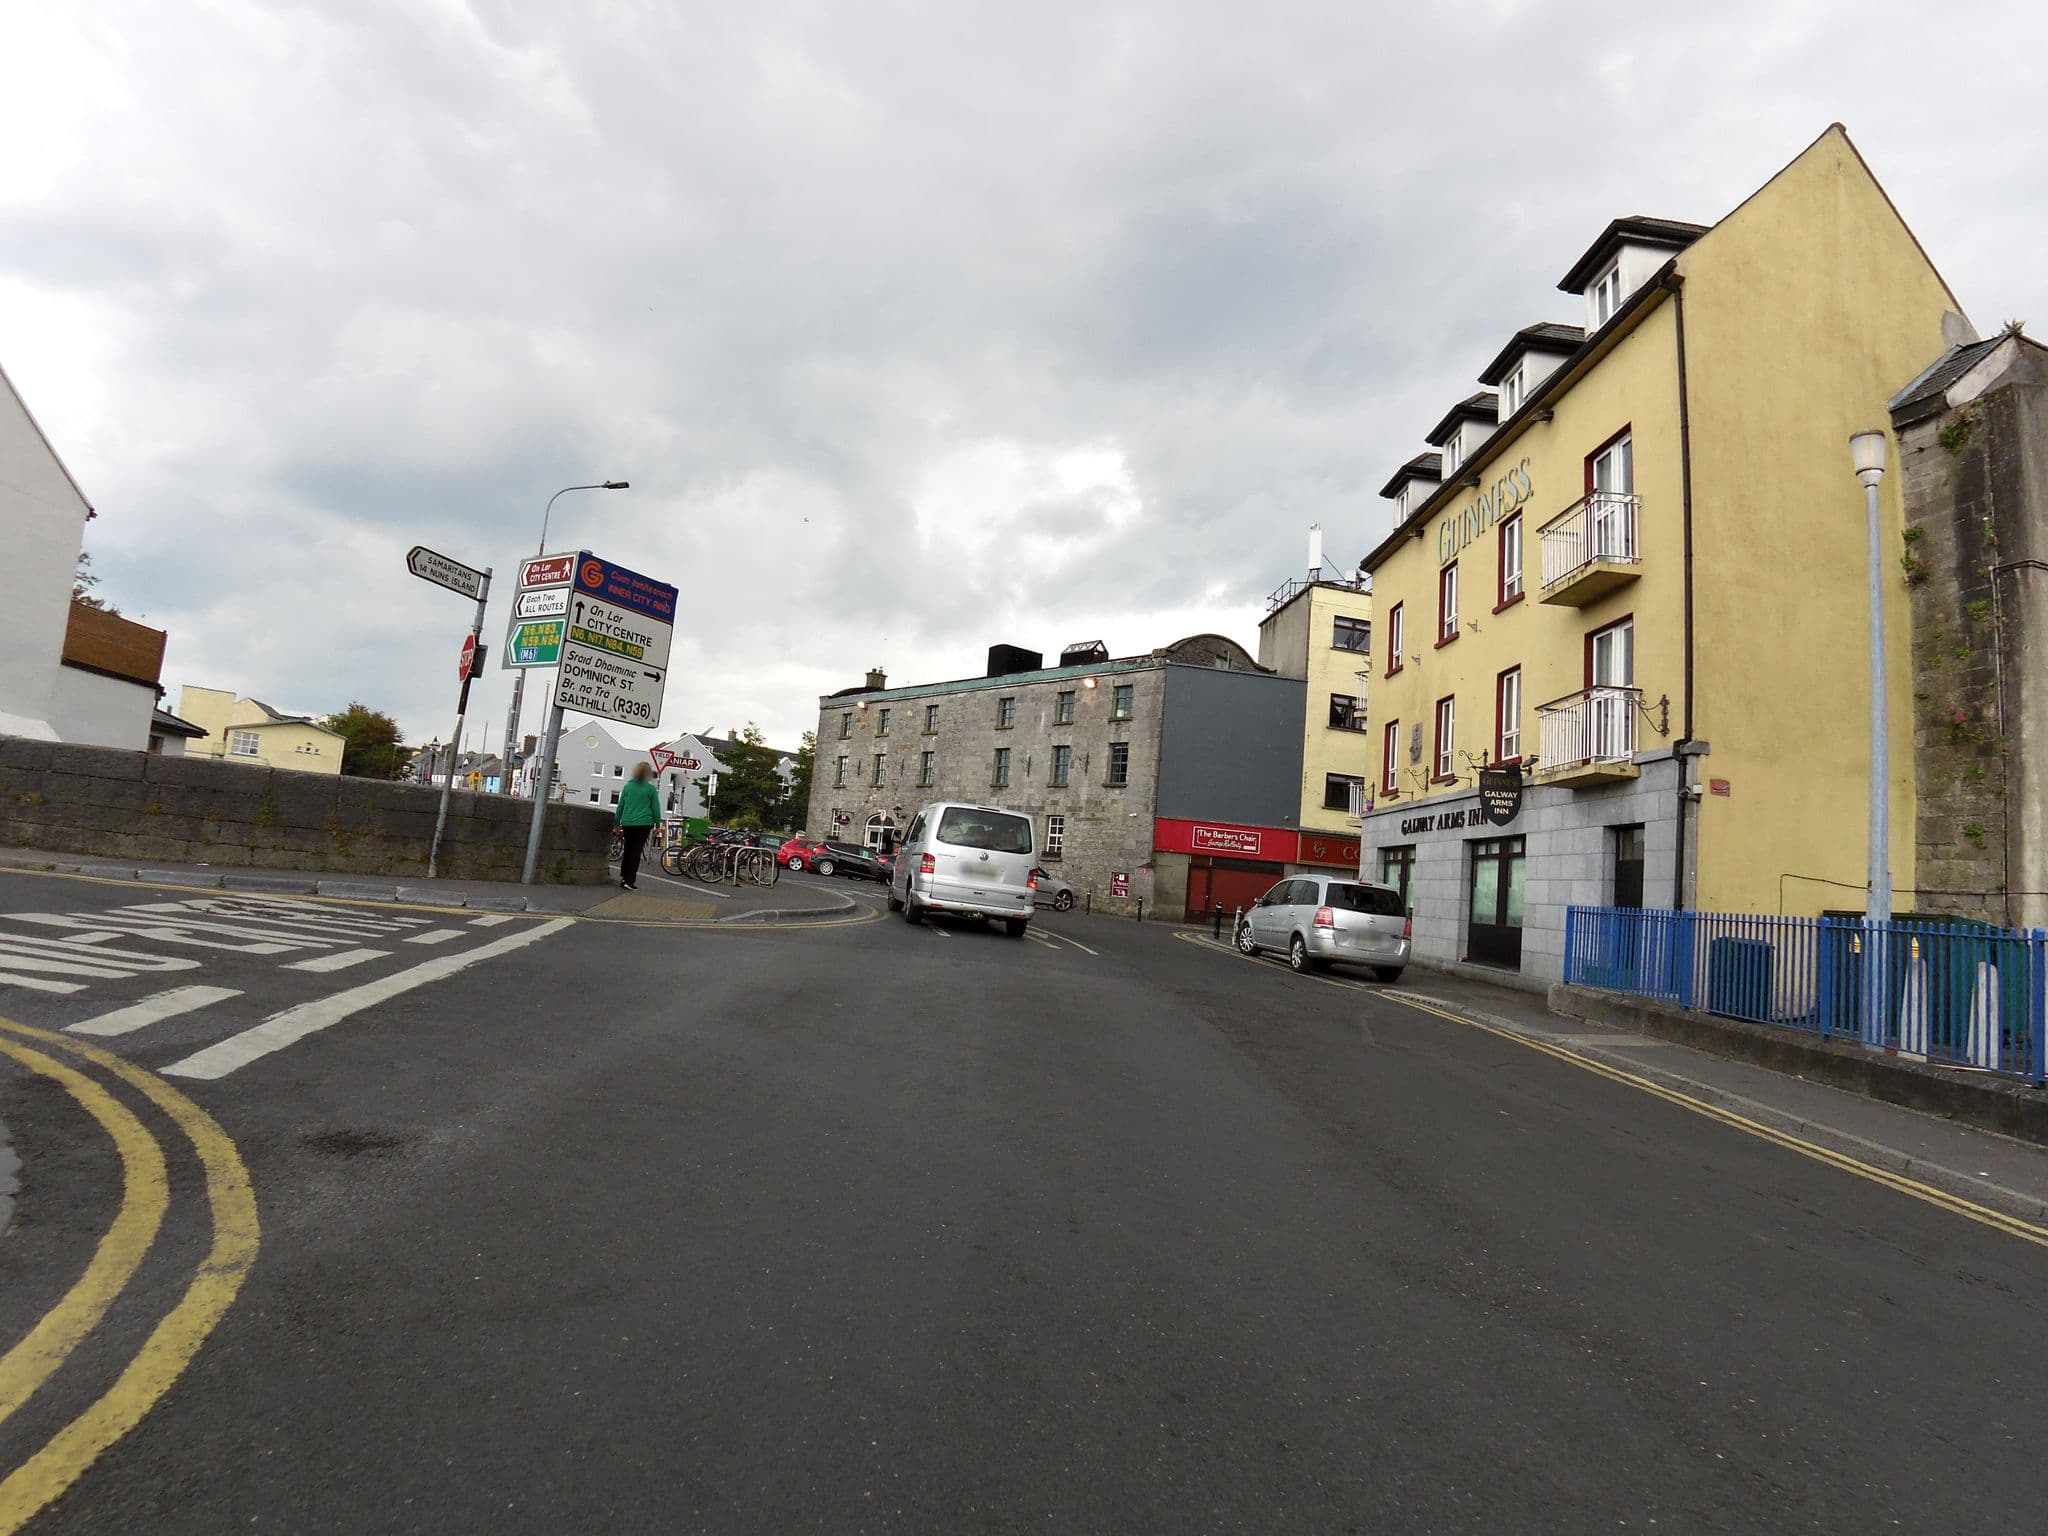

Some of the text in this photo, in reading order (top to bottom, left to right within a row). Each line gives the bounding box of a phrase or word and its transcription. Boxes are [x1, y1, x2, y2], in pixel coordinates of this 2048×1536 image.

[1437, 457, 1532, 566] GUINNESS
[419, 563, 476, 593] 14 NUNS ISLAND
[427, 556, 472, 581] SAMARITANS
[529, 570, 561, 583] CITY CENTRE
[526, 595, 541, 604] Gach
[608, 584, 631, 599] INNER
[632, 593, 651, 606] CITY
[524, 601, 564, 613] ALL ROUTES
[587, 618, 653, 648] CITY CENTRE
[460, 648, 474, 668] STOP
[626, 644, 644, 658] N59
[561, 677, 576, 690] Br.
[579, 683, 593, 694] na
[564, 663, 635, 692] DOMINICK ST.
[559, 691, 608, 713] SALTHILL
[613, 695, 651, 720] (R336)
[1484, 790, 1518, 799] GALWAY
[1490, 799, 1514, 807] ARMS
[1494, 807, 1510, 815] INN
[1401, 814, 1436, 836] GALWAY
[1437, 810, 1466, 831] ARMS
[1199, 829, 1212, 838] The
[1239, 833, 1257, 842] Chair
